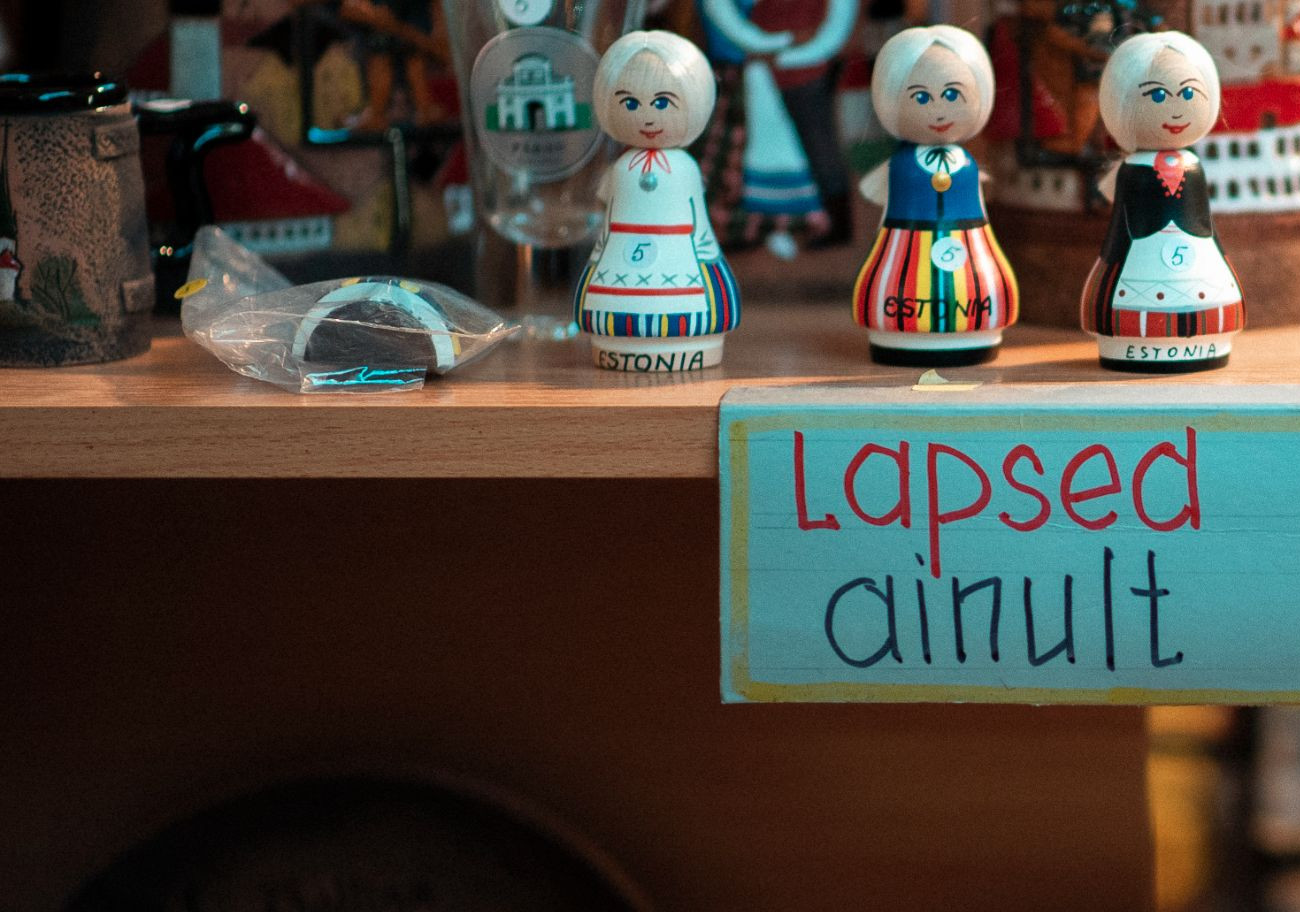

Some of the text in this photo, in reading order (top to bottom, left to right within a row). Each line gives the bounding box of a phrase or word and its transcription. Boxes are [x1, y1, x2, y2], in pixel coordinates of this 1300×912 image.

[631, 242, 652, 262] 5
[1171, 246, 1188, 266] 5
[883, 296, 992, 320] ESTONIA
[599, 350, 704, 373] ESTONIA
[1126, 343, 1217, 360] ESTONIA
[793, 426, 1201, 579] Lapsed
[824, 546, 1185, 672] ainult
